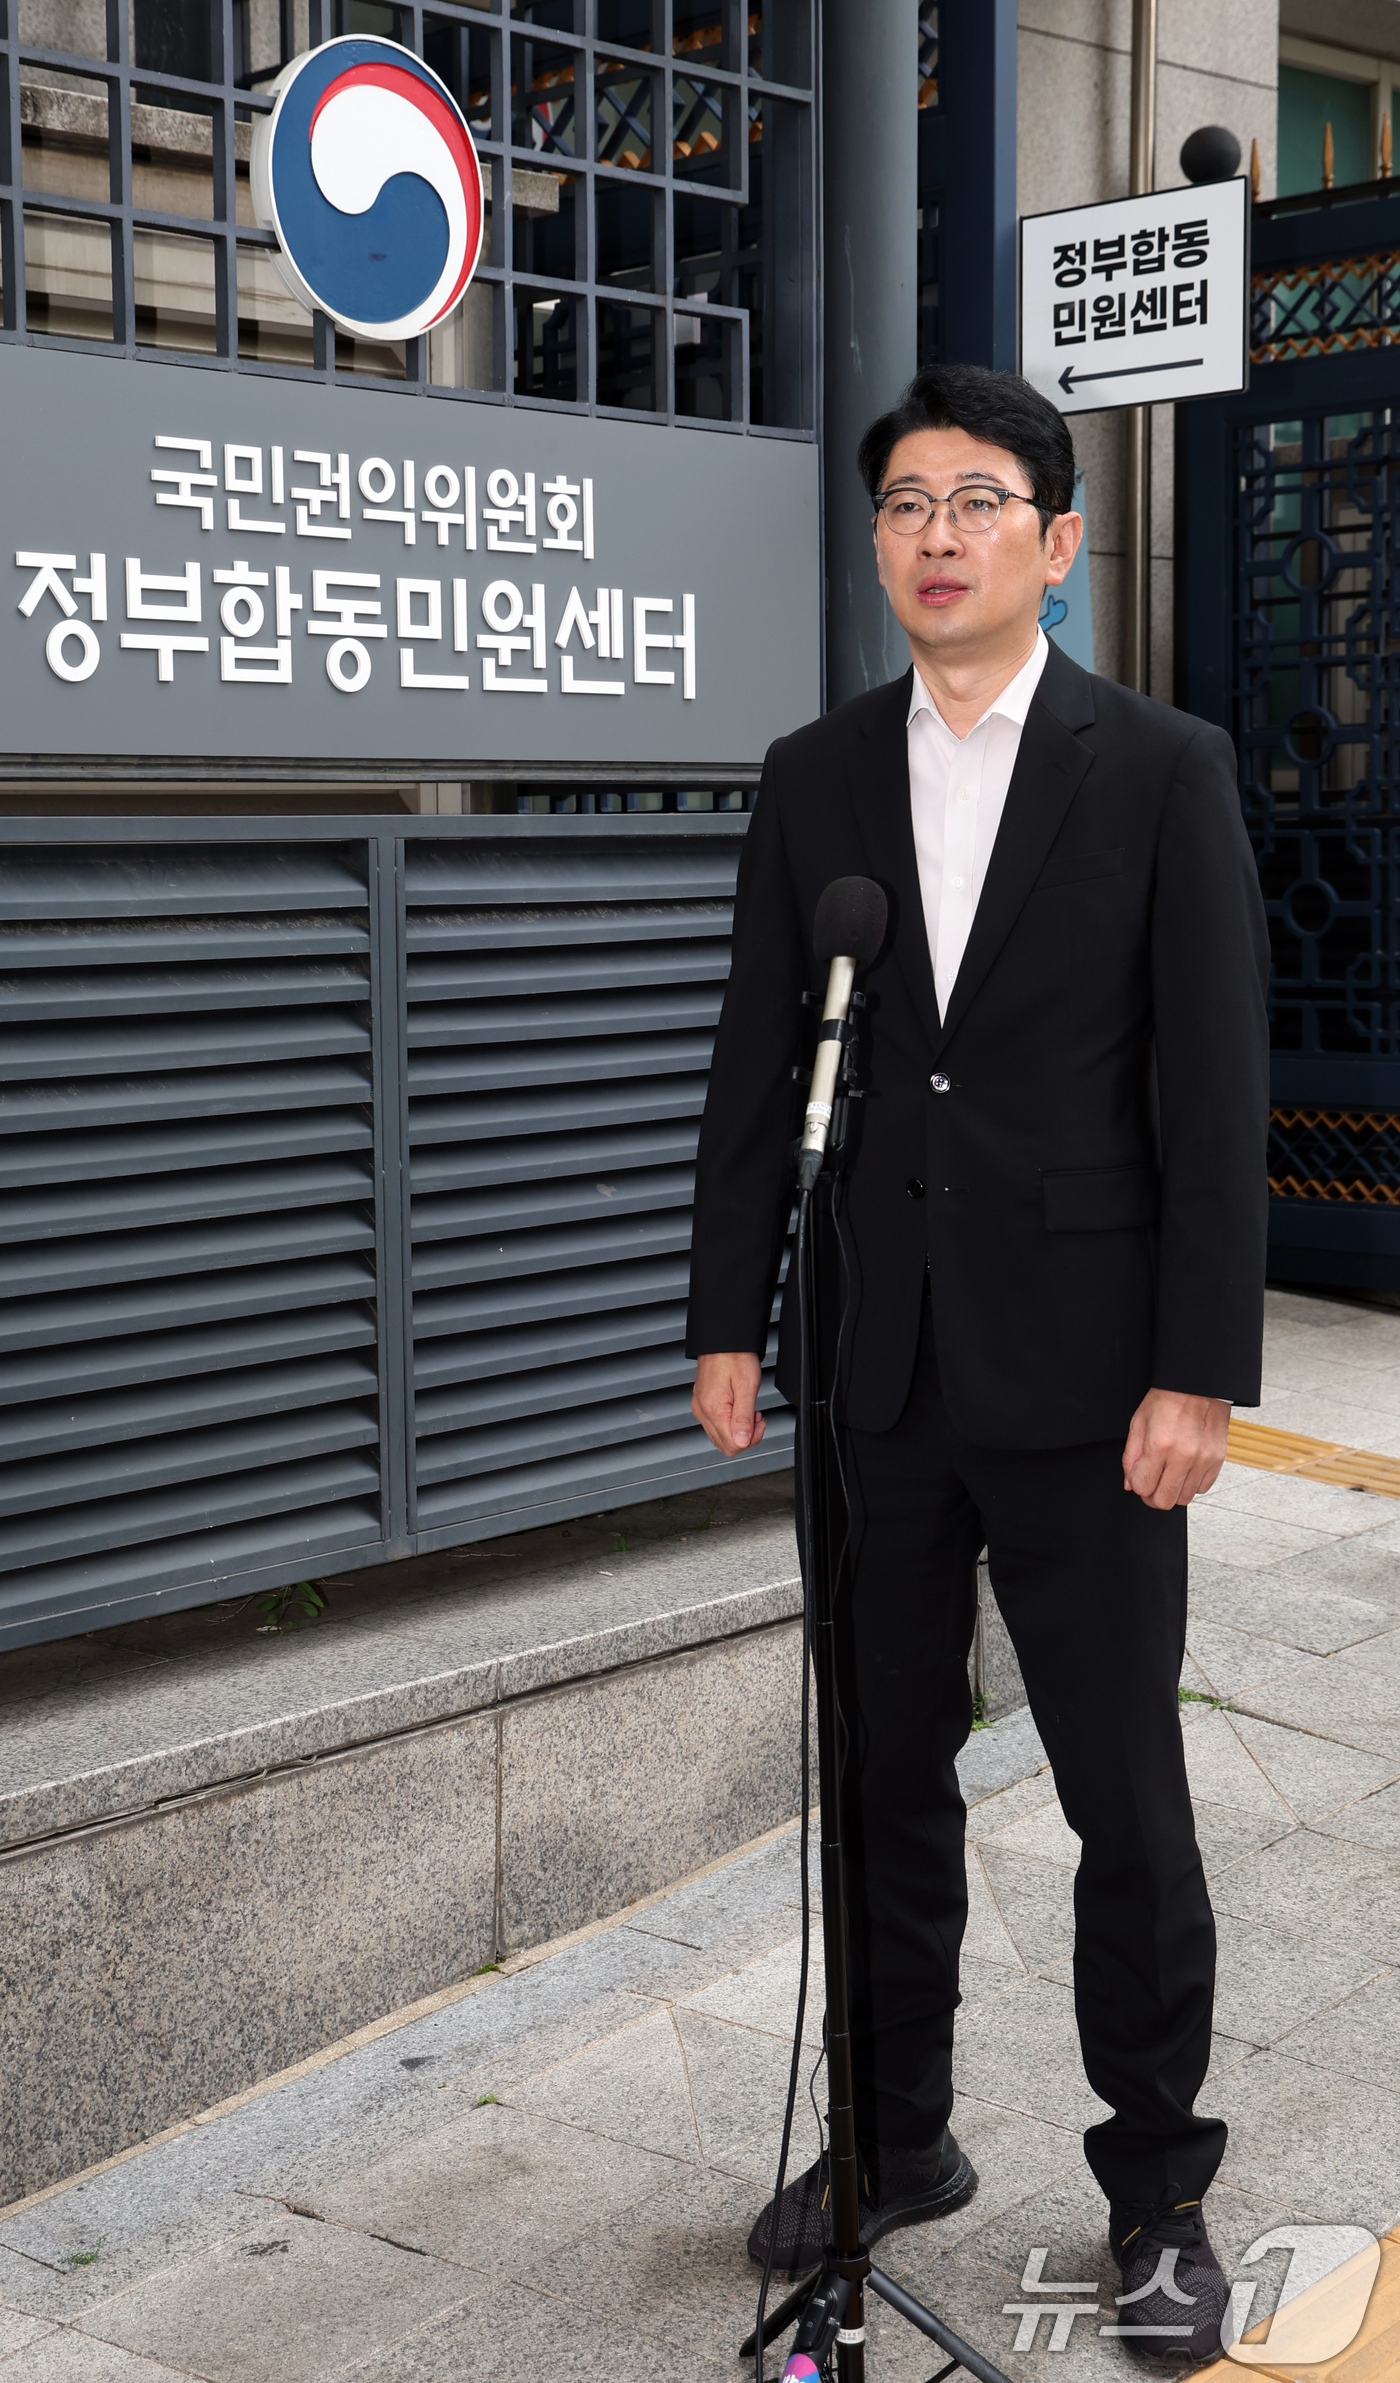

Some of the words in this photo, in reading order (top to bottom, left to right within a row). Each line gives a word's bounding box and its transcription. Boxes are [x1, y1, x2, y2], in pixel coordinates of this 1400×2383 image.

[1053, 219, 1210, 289] 정부합동
[1053, 278, 1208, 347] 민원센터
[151, 435, 595, 560] 국민권익위원회
[15, 550, 696, 700] 정부합동민원센터
